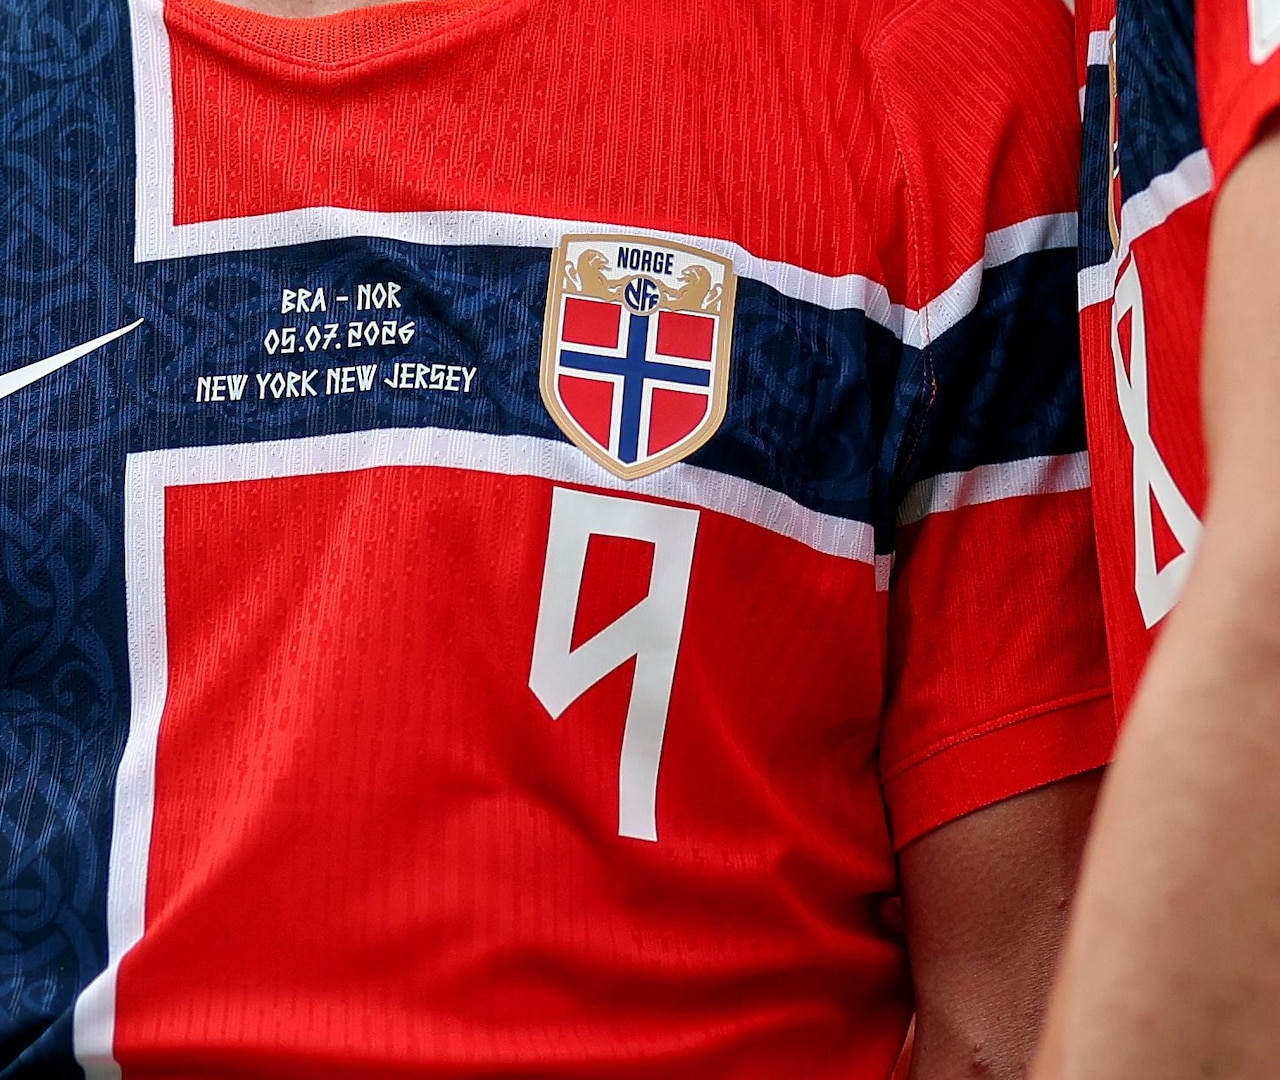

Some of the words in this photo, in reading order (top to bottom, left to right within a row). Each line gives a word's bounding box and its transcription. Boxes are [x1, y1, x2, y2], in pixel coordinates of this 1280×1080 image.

[617, 247, 674, 275] NORGE
[281, 288, 326, 313] BRA
[357, 281, 402, 310] NOR
[264, 321, 416, 354] 05.07.2026
[196, 374, 247, 402] NEW
[256, 369, 318, 399] YORK
[325, 364, 377, 395] NEW
[384, 362, 477, 392] JERSEY
[529, 486, 700, 842] 9
